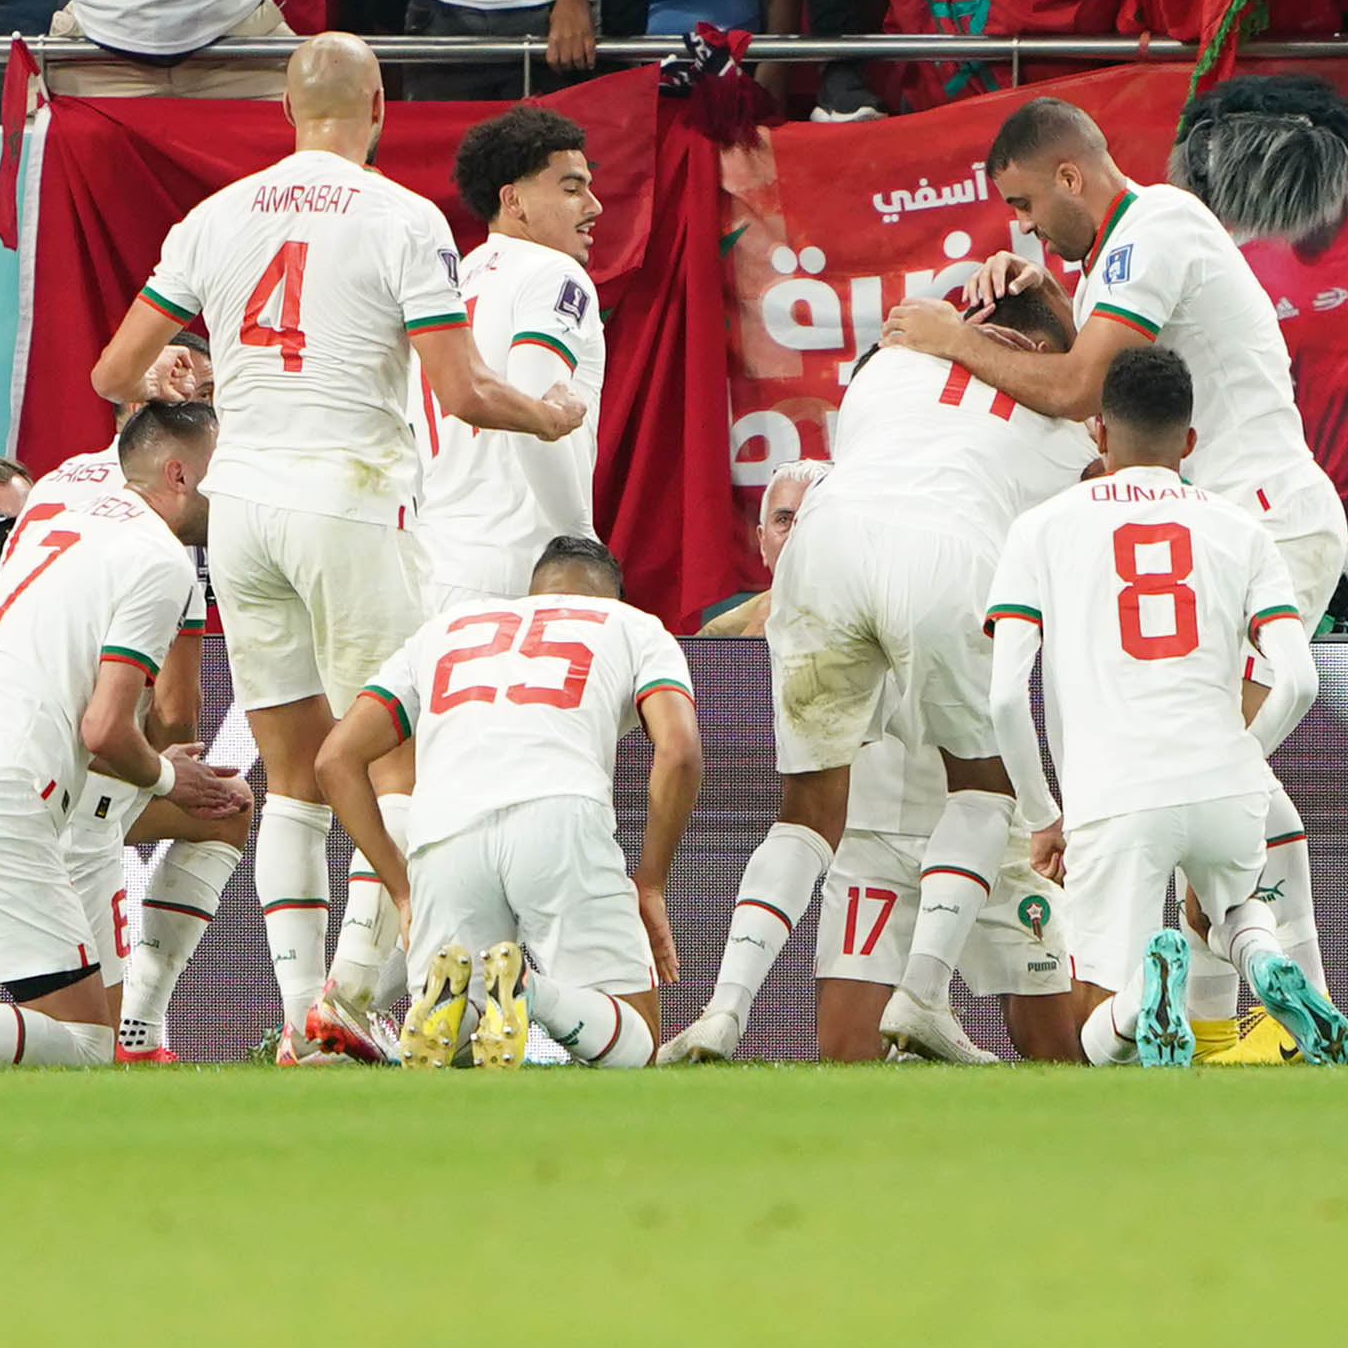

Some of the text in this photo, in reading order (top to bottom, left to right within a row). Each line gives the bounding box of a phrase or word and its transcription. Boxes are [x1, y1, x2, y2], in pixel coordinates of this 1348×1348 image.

[251, 184, 361, 214] AMRABAT
[238, 240, 309, 373] 4
[1091, 482, 1209, 503] OUNAHI
[1112, 521, 1200, 661] 8
[428, 607, 610, 715] 25
[842, 886, 898, 956] 17
[1027, 960, 1057, 973] PUMA
